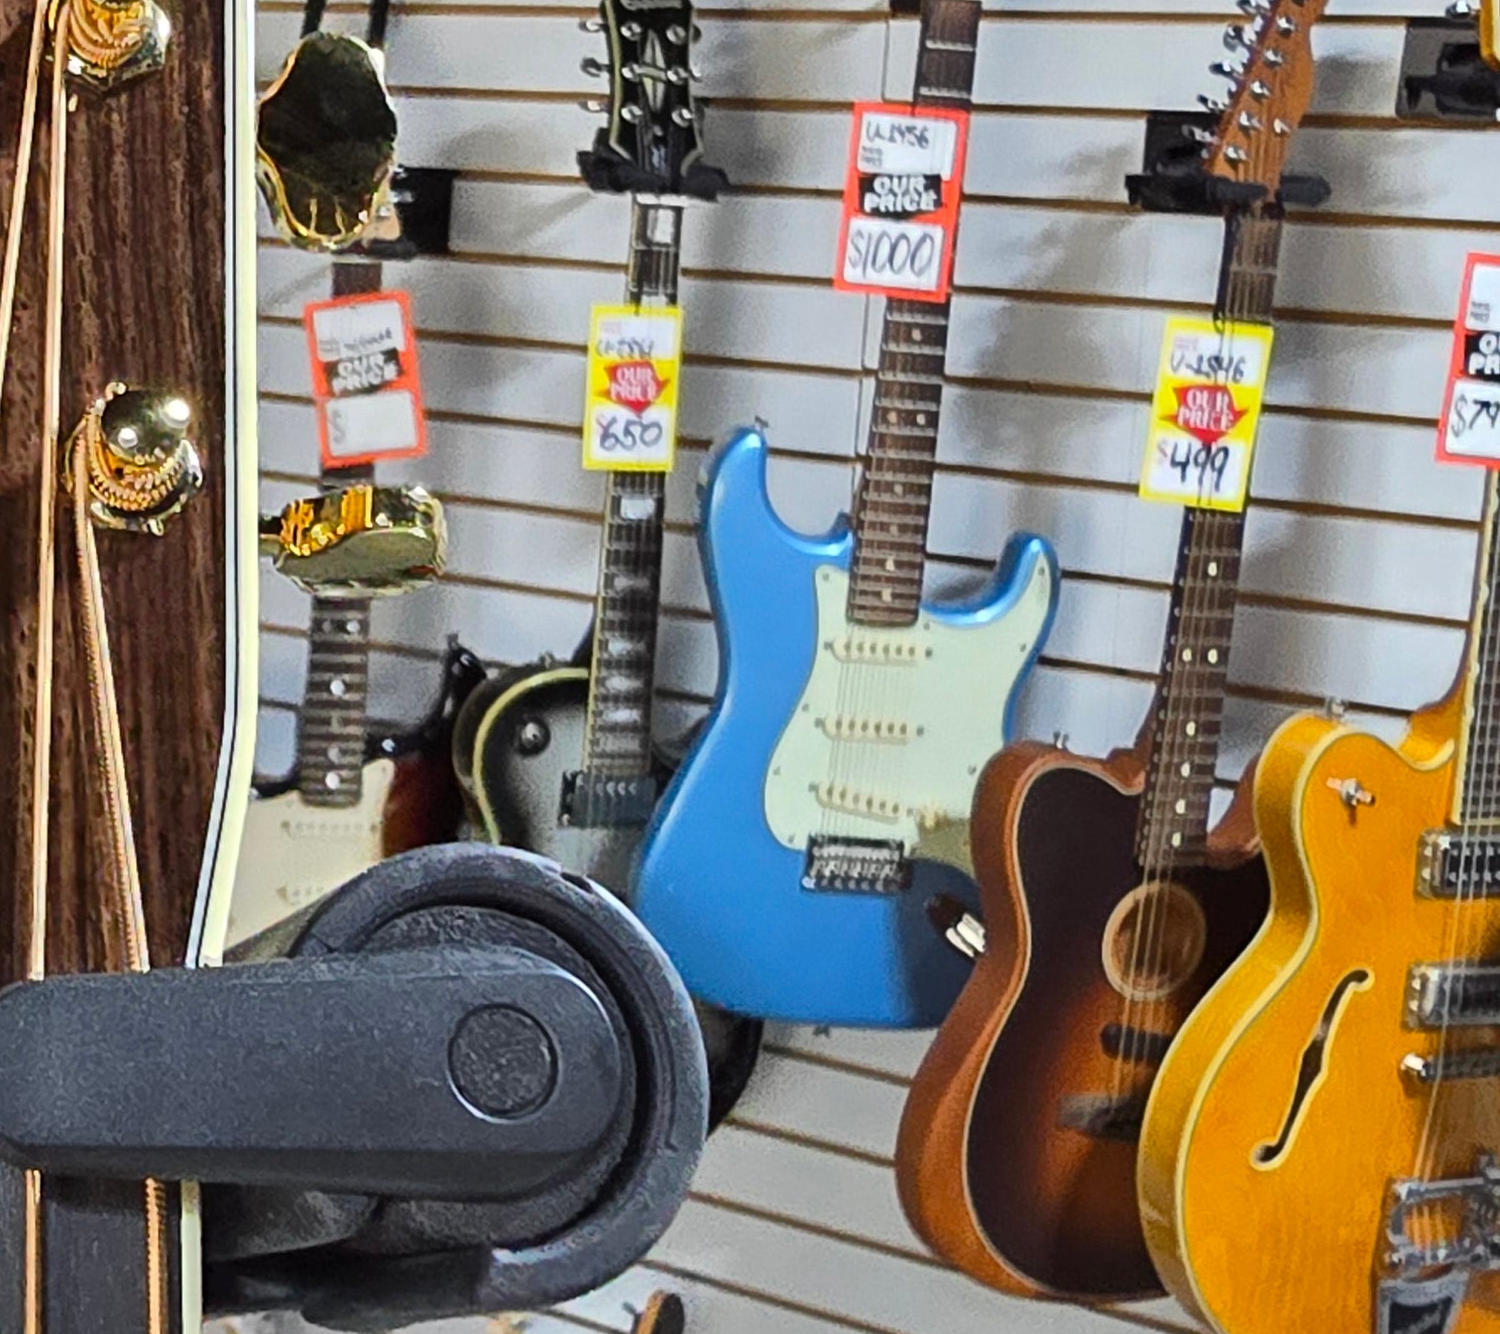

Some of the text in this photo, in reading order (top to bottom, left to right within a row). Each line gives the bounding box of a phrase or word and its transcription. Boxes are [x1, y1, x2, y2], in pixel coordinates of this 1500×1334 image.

[872, 175, 927, 196] OUR
[863, 191, 938, 213] PRICE
[848, 228, 936, 280] $1000
[1186, 387, 1231, 411] OUR
[1177, 404, 1237, 433] PRICE
